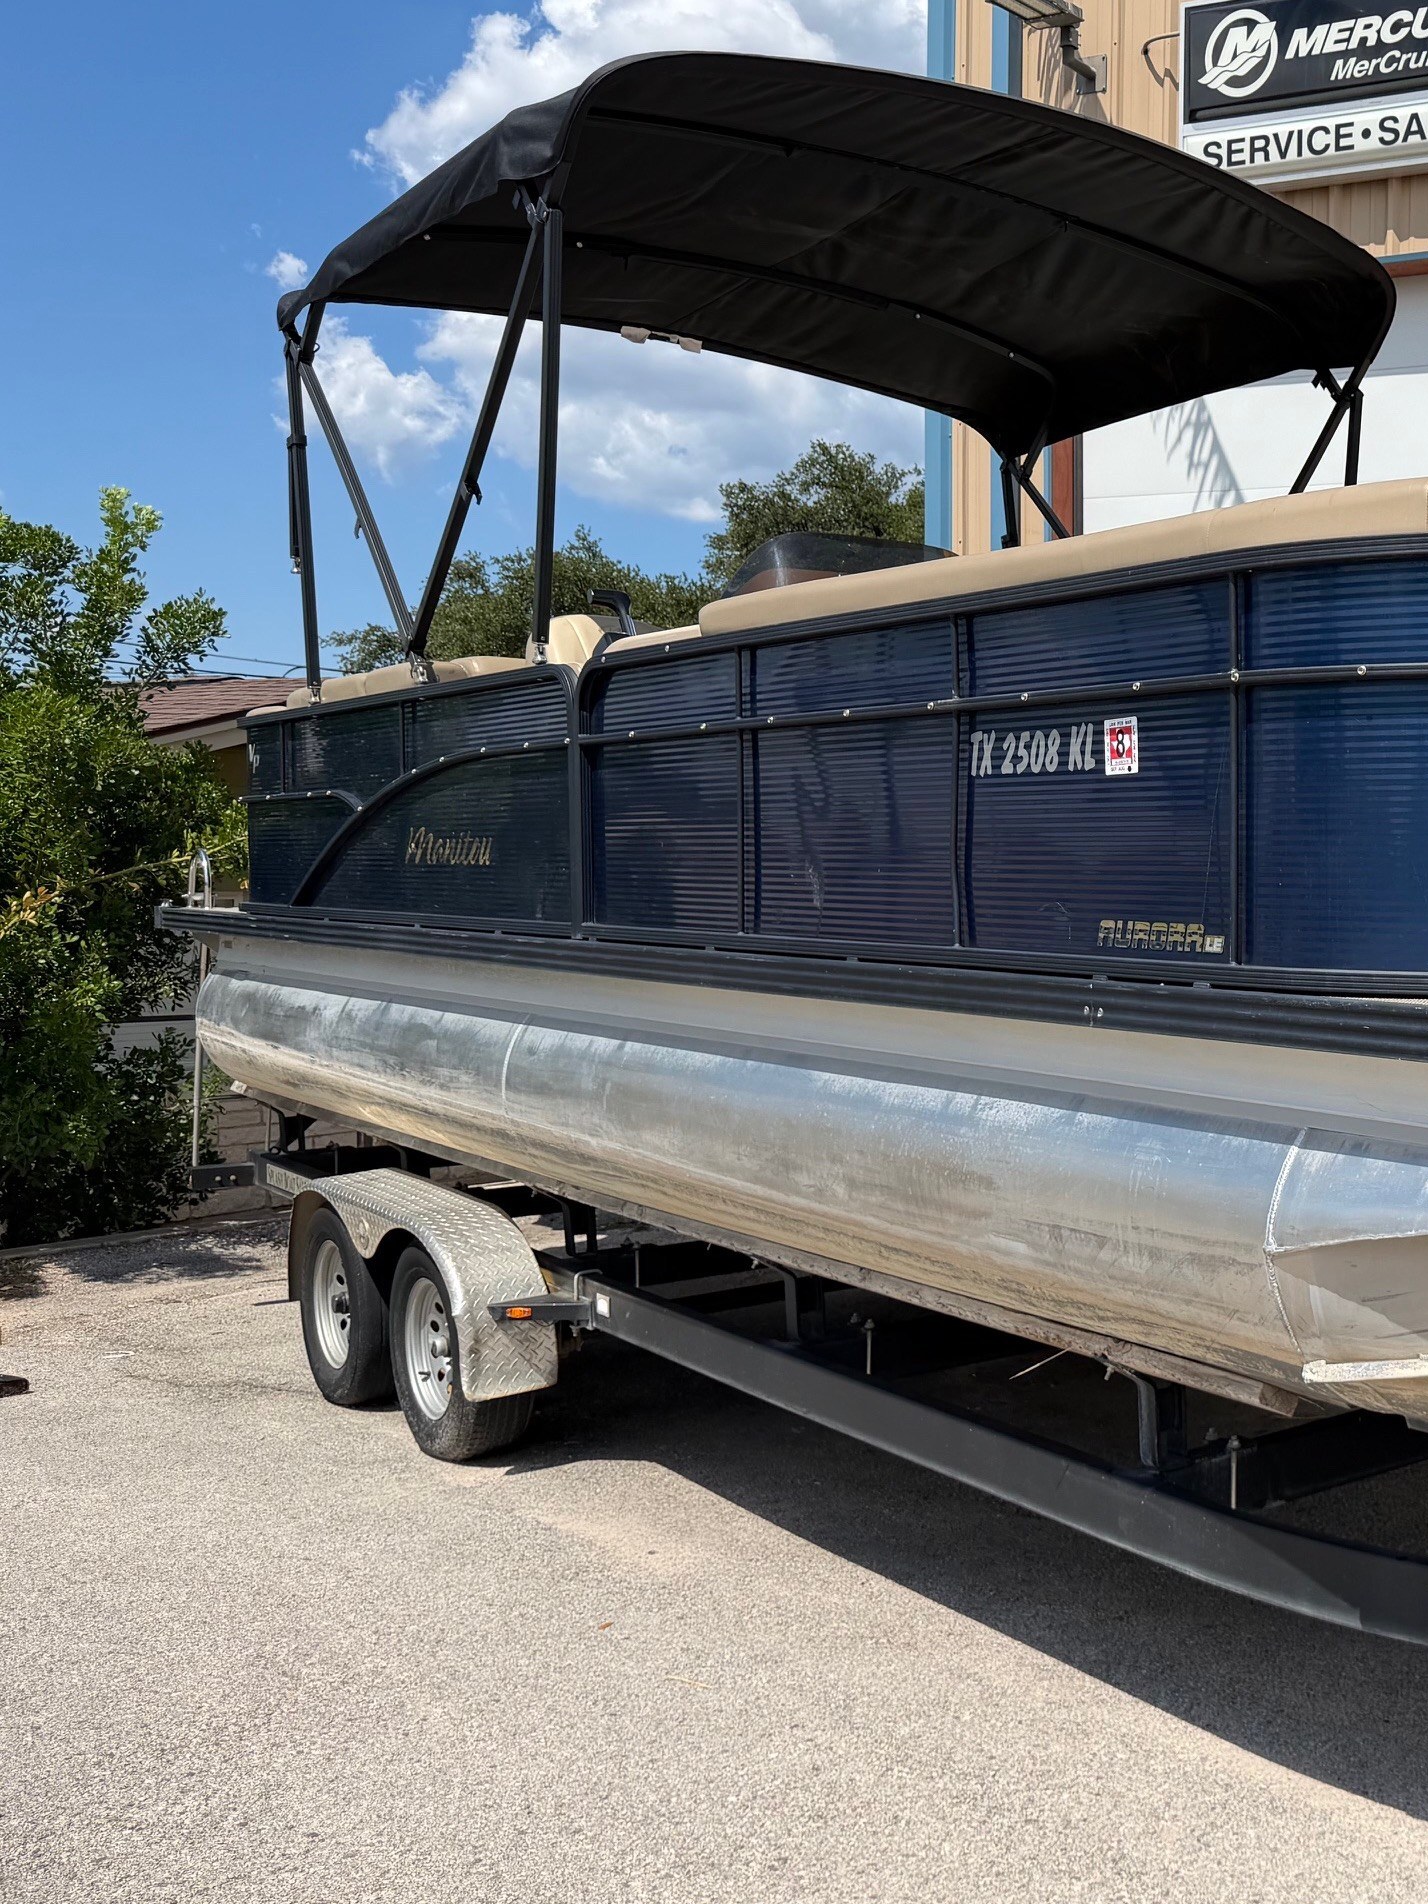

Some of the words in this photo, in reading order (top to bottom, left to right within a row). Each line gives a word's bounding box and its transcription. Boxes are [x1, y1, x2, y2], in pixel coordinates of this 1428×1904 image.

[970, 730, 995, 777] TX
[1001, 729, 1060, 774] 2508
[1068, 722, 1096, 772] KL
[1116, 728, 1125, 758] 8
[405, 827, 493, 866] Manitou
[1097, 919, 1205, 953] AURORA
[1205, 936, 1225, 954] LE
